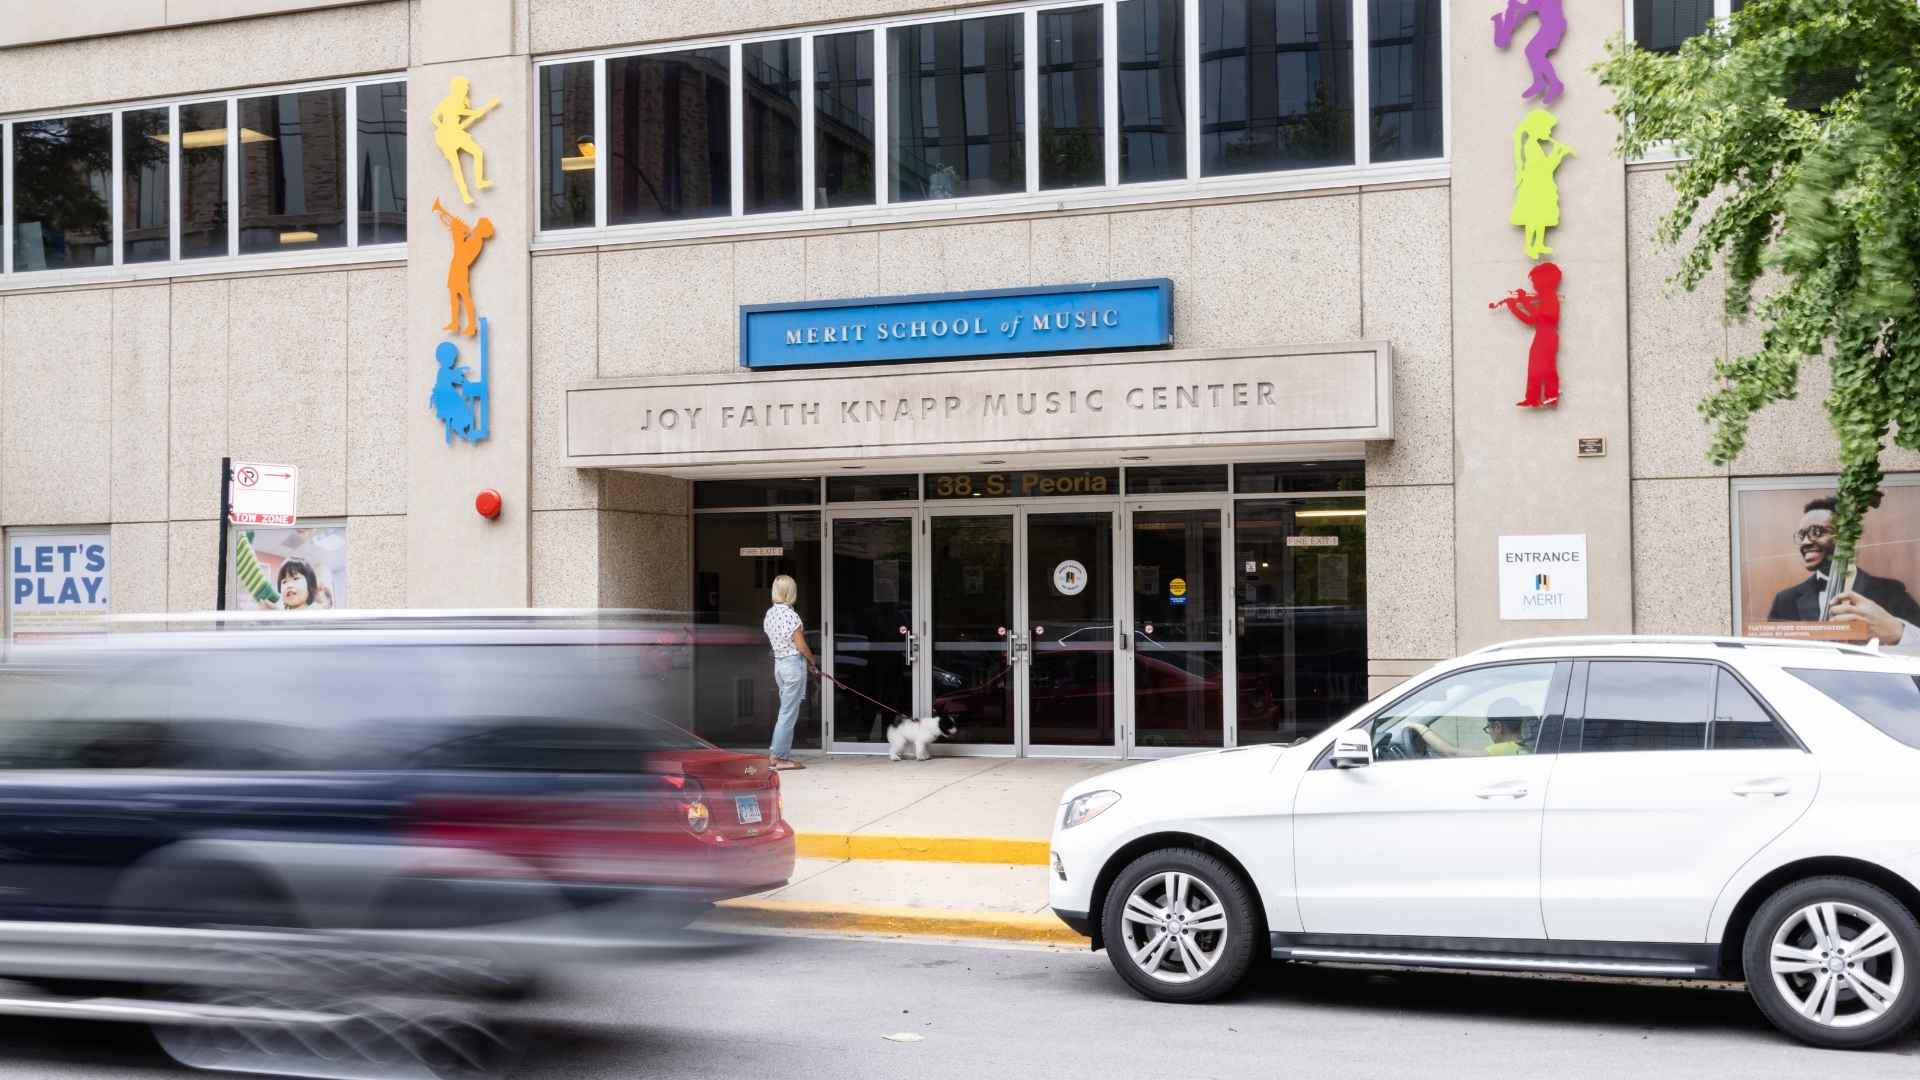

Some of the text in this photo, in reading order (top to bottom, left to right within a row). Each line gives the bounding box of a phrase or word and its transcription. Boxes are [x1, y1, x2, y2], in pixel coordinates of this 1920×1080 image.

[786, 307, 1120, 345] MERIT SCHOOL of MUSIC
[640, 381, 1277, 431] JOY FAITH KNAPP MUSIC CENTER
[937, 471, 1108, 496] 38 S. Peoria
[235, 513, 289, 523] TOW ZONE
[14, 544, 105, 573] LET'S
[1505, 551, 1580, 563] ENTRANCE
[14, 577, 107, 604] PLAY.
[1523, 593, 1565, 606] MERIT
